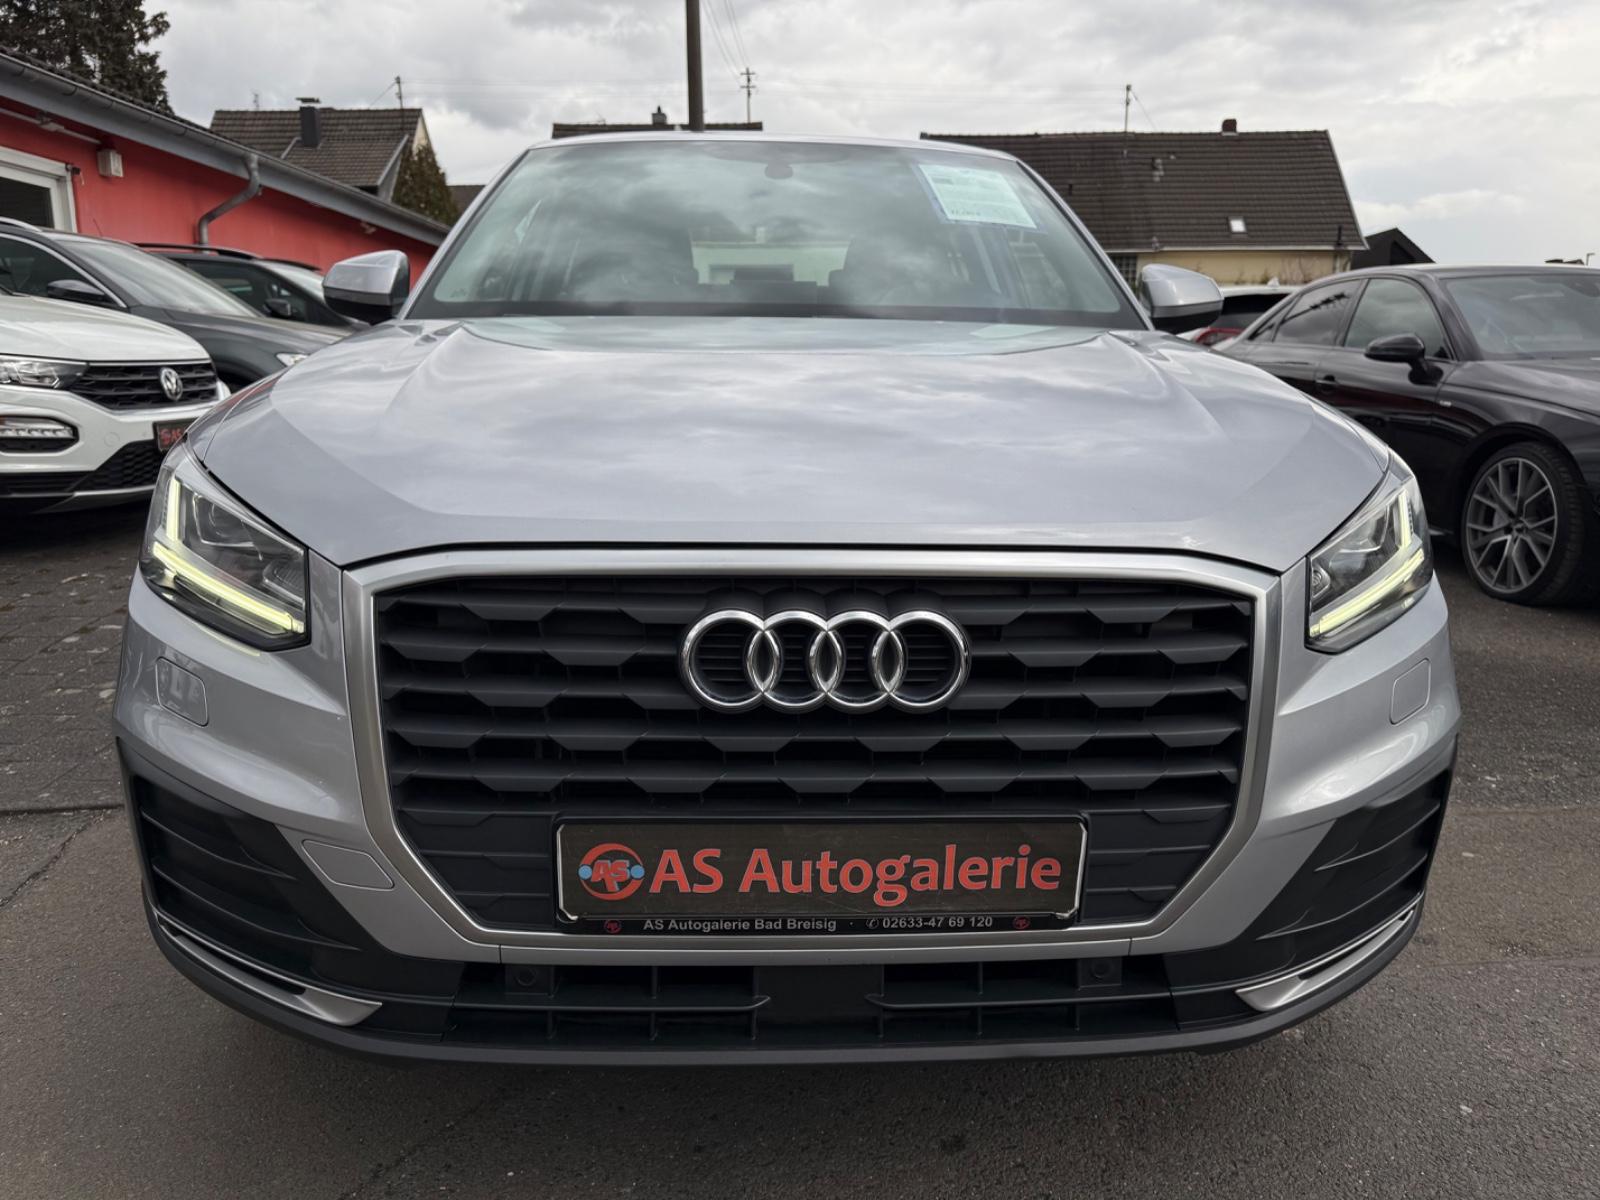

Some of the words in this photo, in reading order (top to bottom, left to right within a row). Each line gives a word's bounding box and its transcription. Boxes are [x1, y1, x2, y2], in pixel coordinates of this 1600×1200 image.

[649, 848, 724, 894] AS
[738, 844, 1062, 907] Autogalerie
[643, 919, 664, 930] AS
[668, 919, 750, 932] Autogalerie
[754, 918, 782, 930] Bad
[787, 918, 837, 932] Breisig
[882, 916, 943, 929] 02633-47
[948, 916, 965, 928] 69
[970, 916, 993, 927] 120
